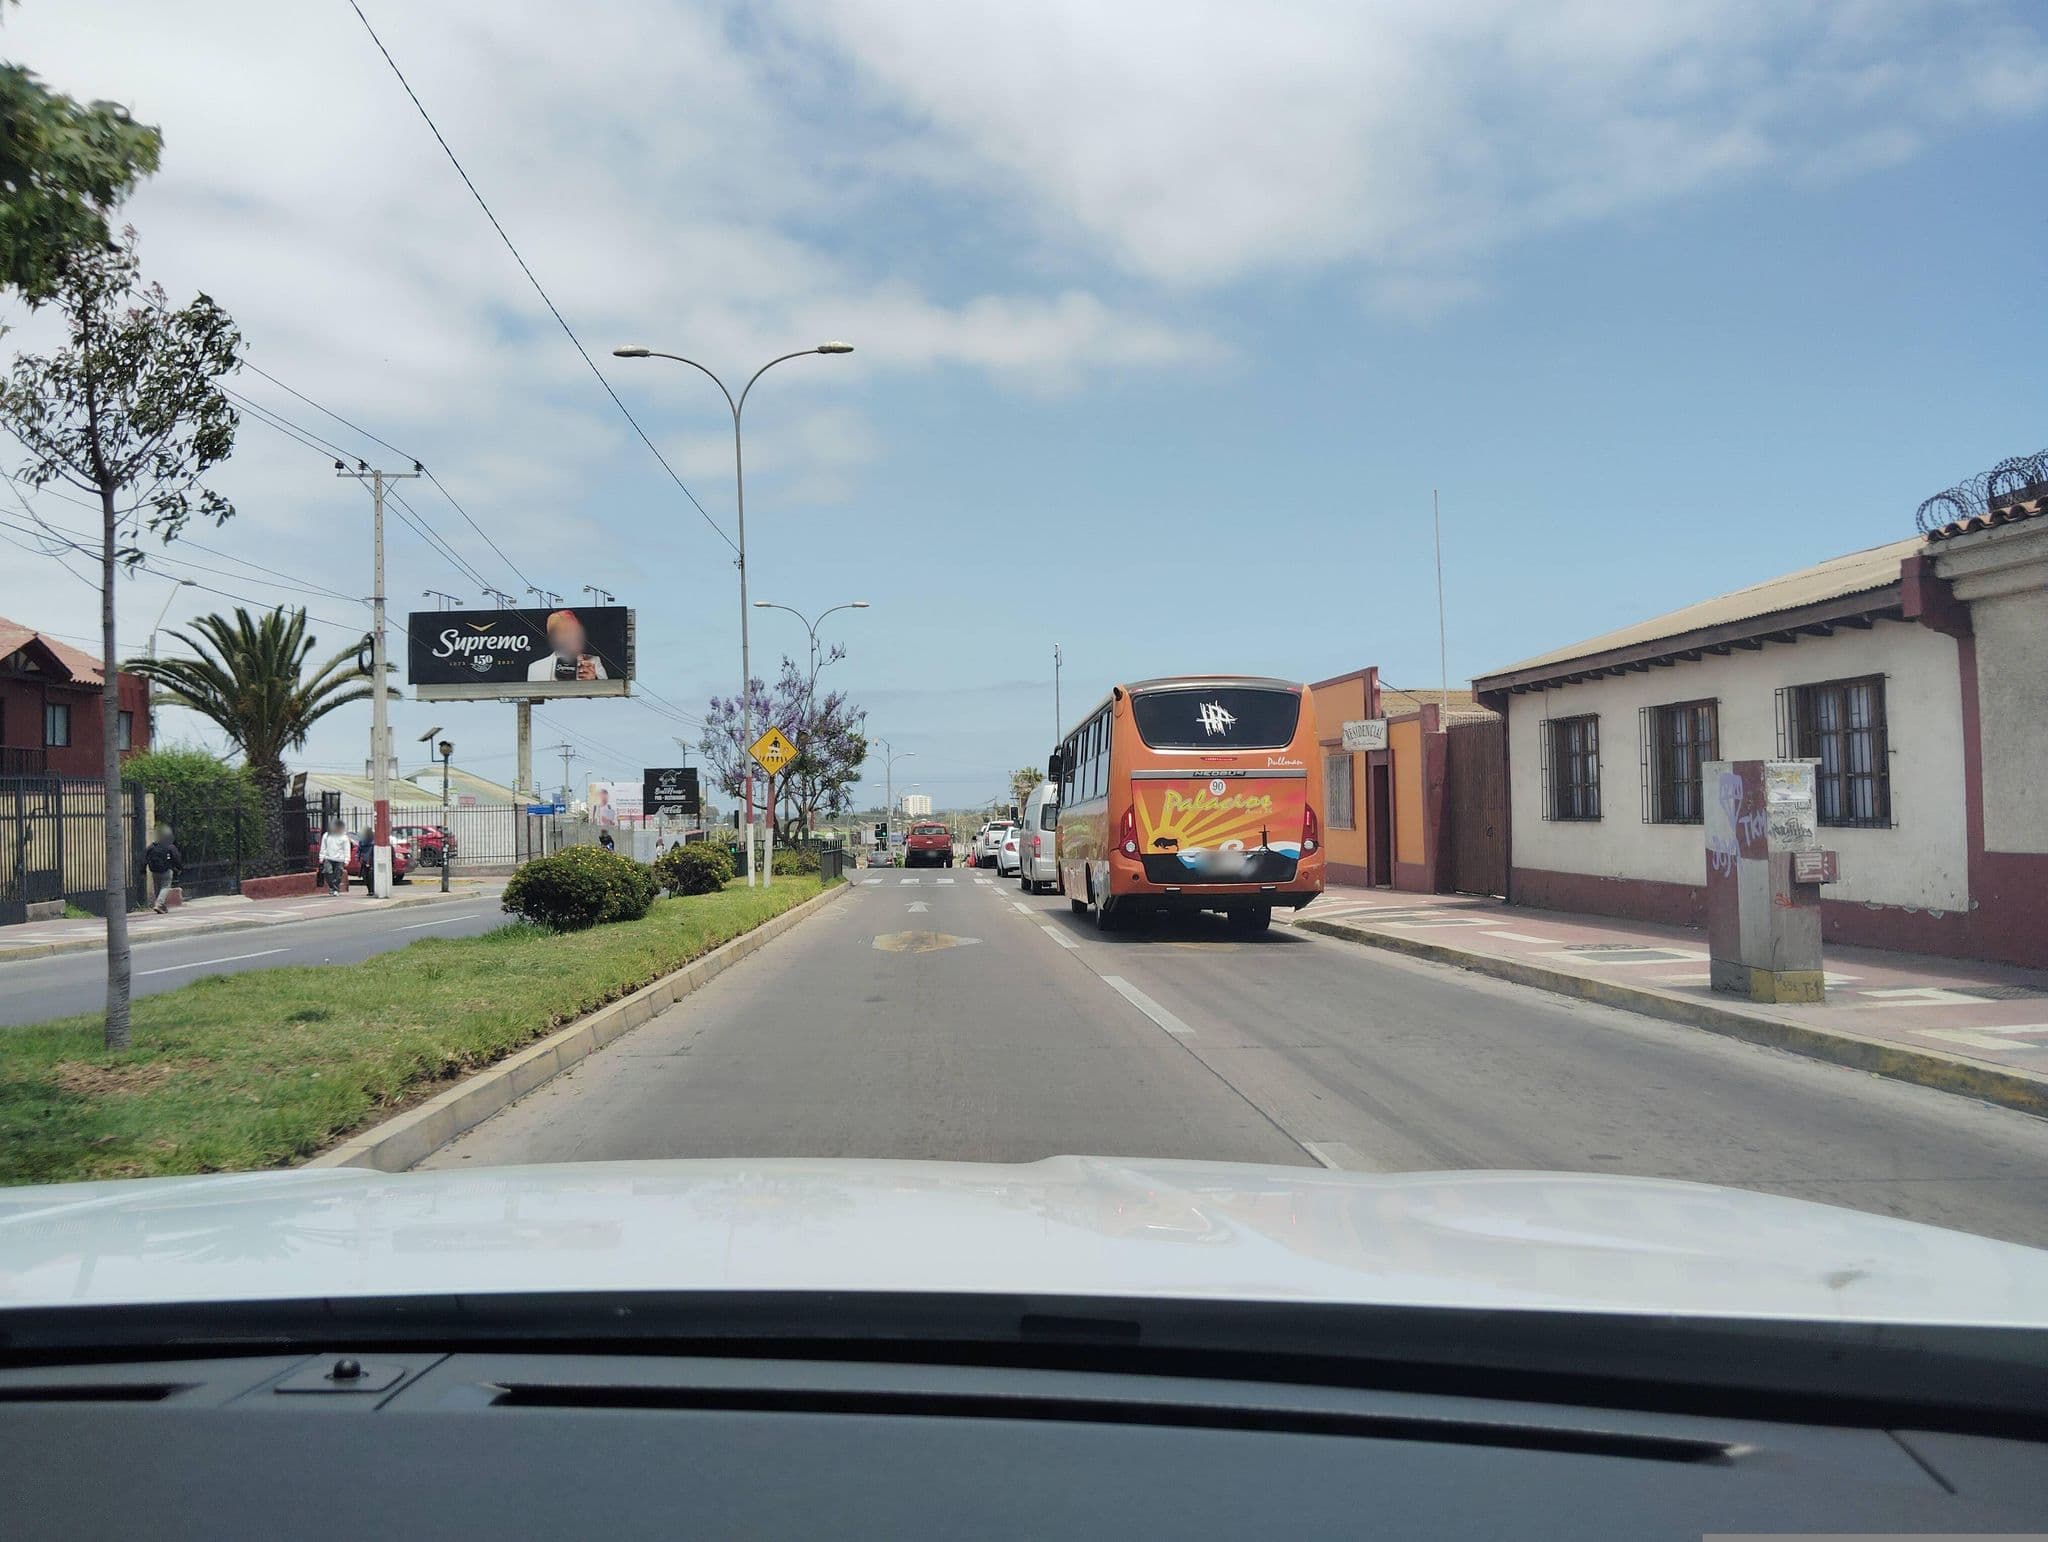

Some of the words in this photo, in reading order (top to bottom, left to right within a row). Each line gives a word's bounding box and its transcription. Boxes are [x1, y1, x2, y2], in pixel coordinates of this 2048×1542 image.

[432, 629, 528, 657] Supremo
[473, 654, 493, 665] 150
[1267, 756, 1304, 768] Pullman
[1212, 781, 1224, 791] 90
